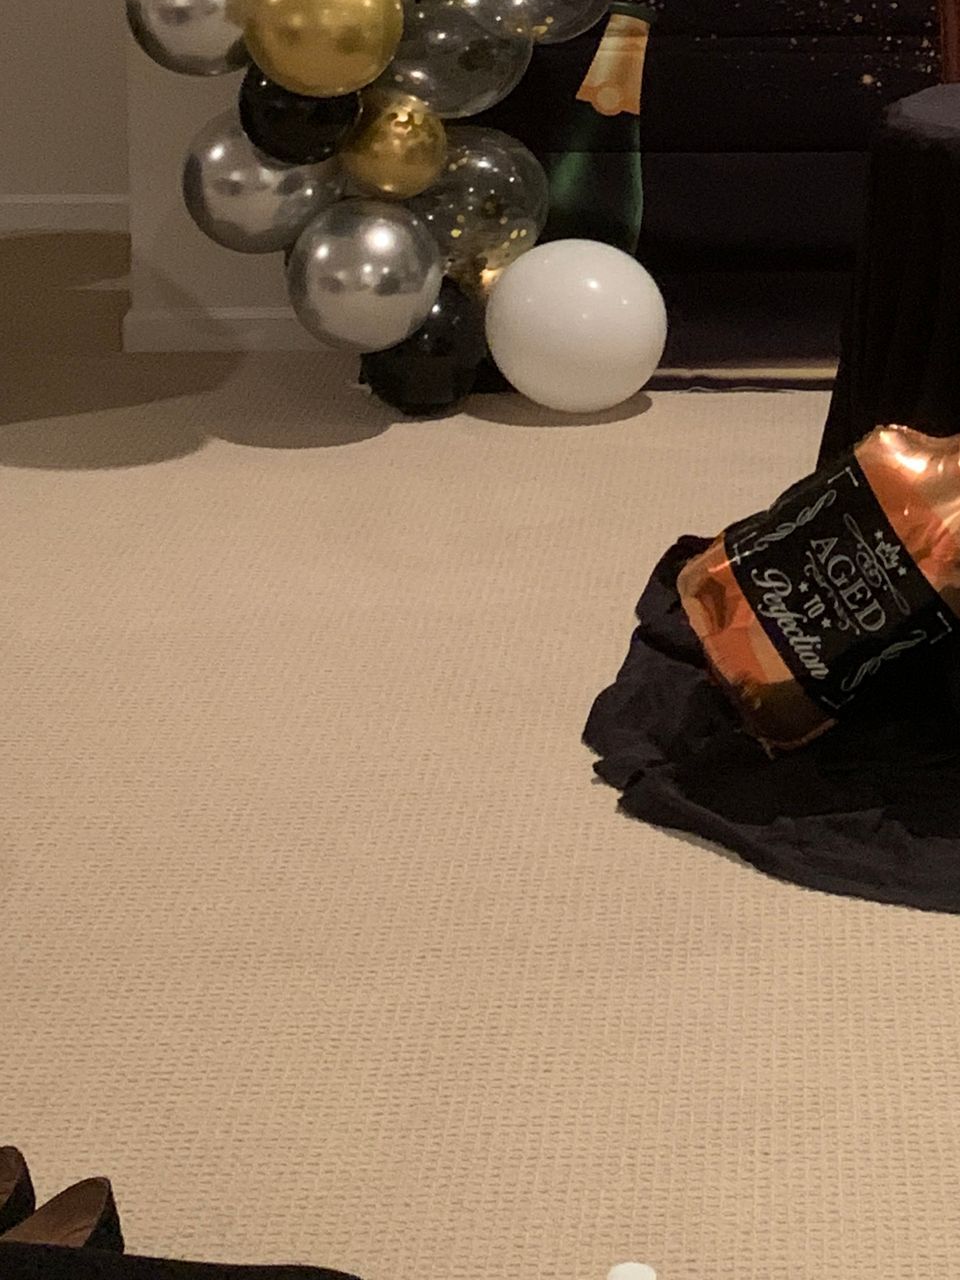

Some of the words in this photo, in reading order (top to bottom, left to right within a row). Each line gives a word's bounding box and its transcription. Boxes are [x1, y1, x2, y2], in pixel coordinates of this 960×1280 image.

[751, 568, 829, 680] Perfection
[803, 593, 826, 619] TO
[810, 536, 887, 632] AGED
